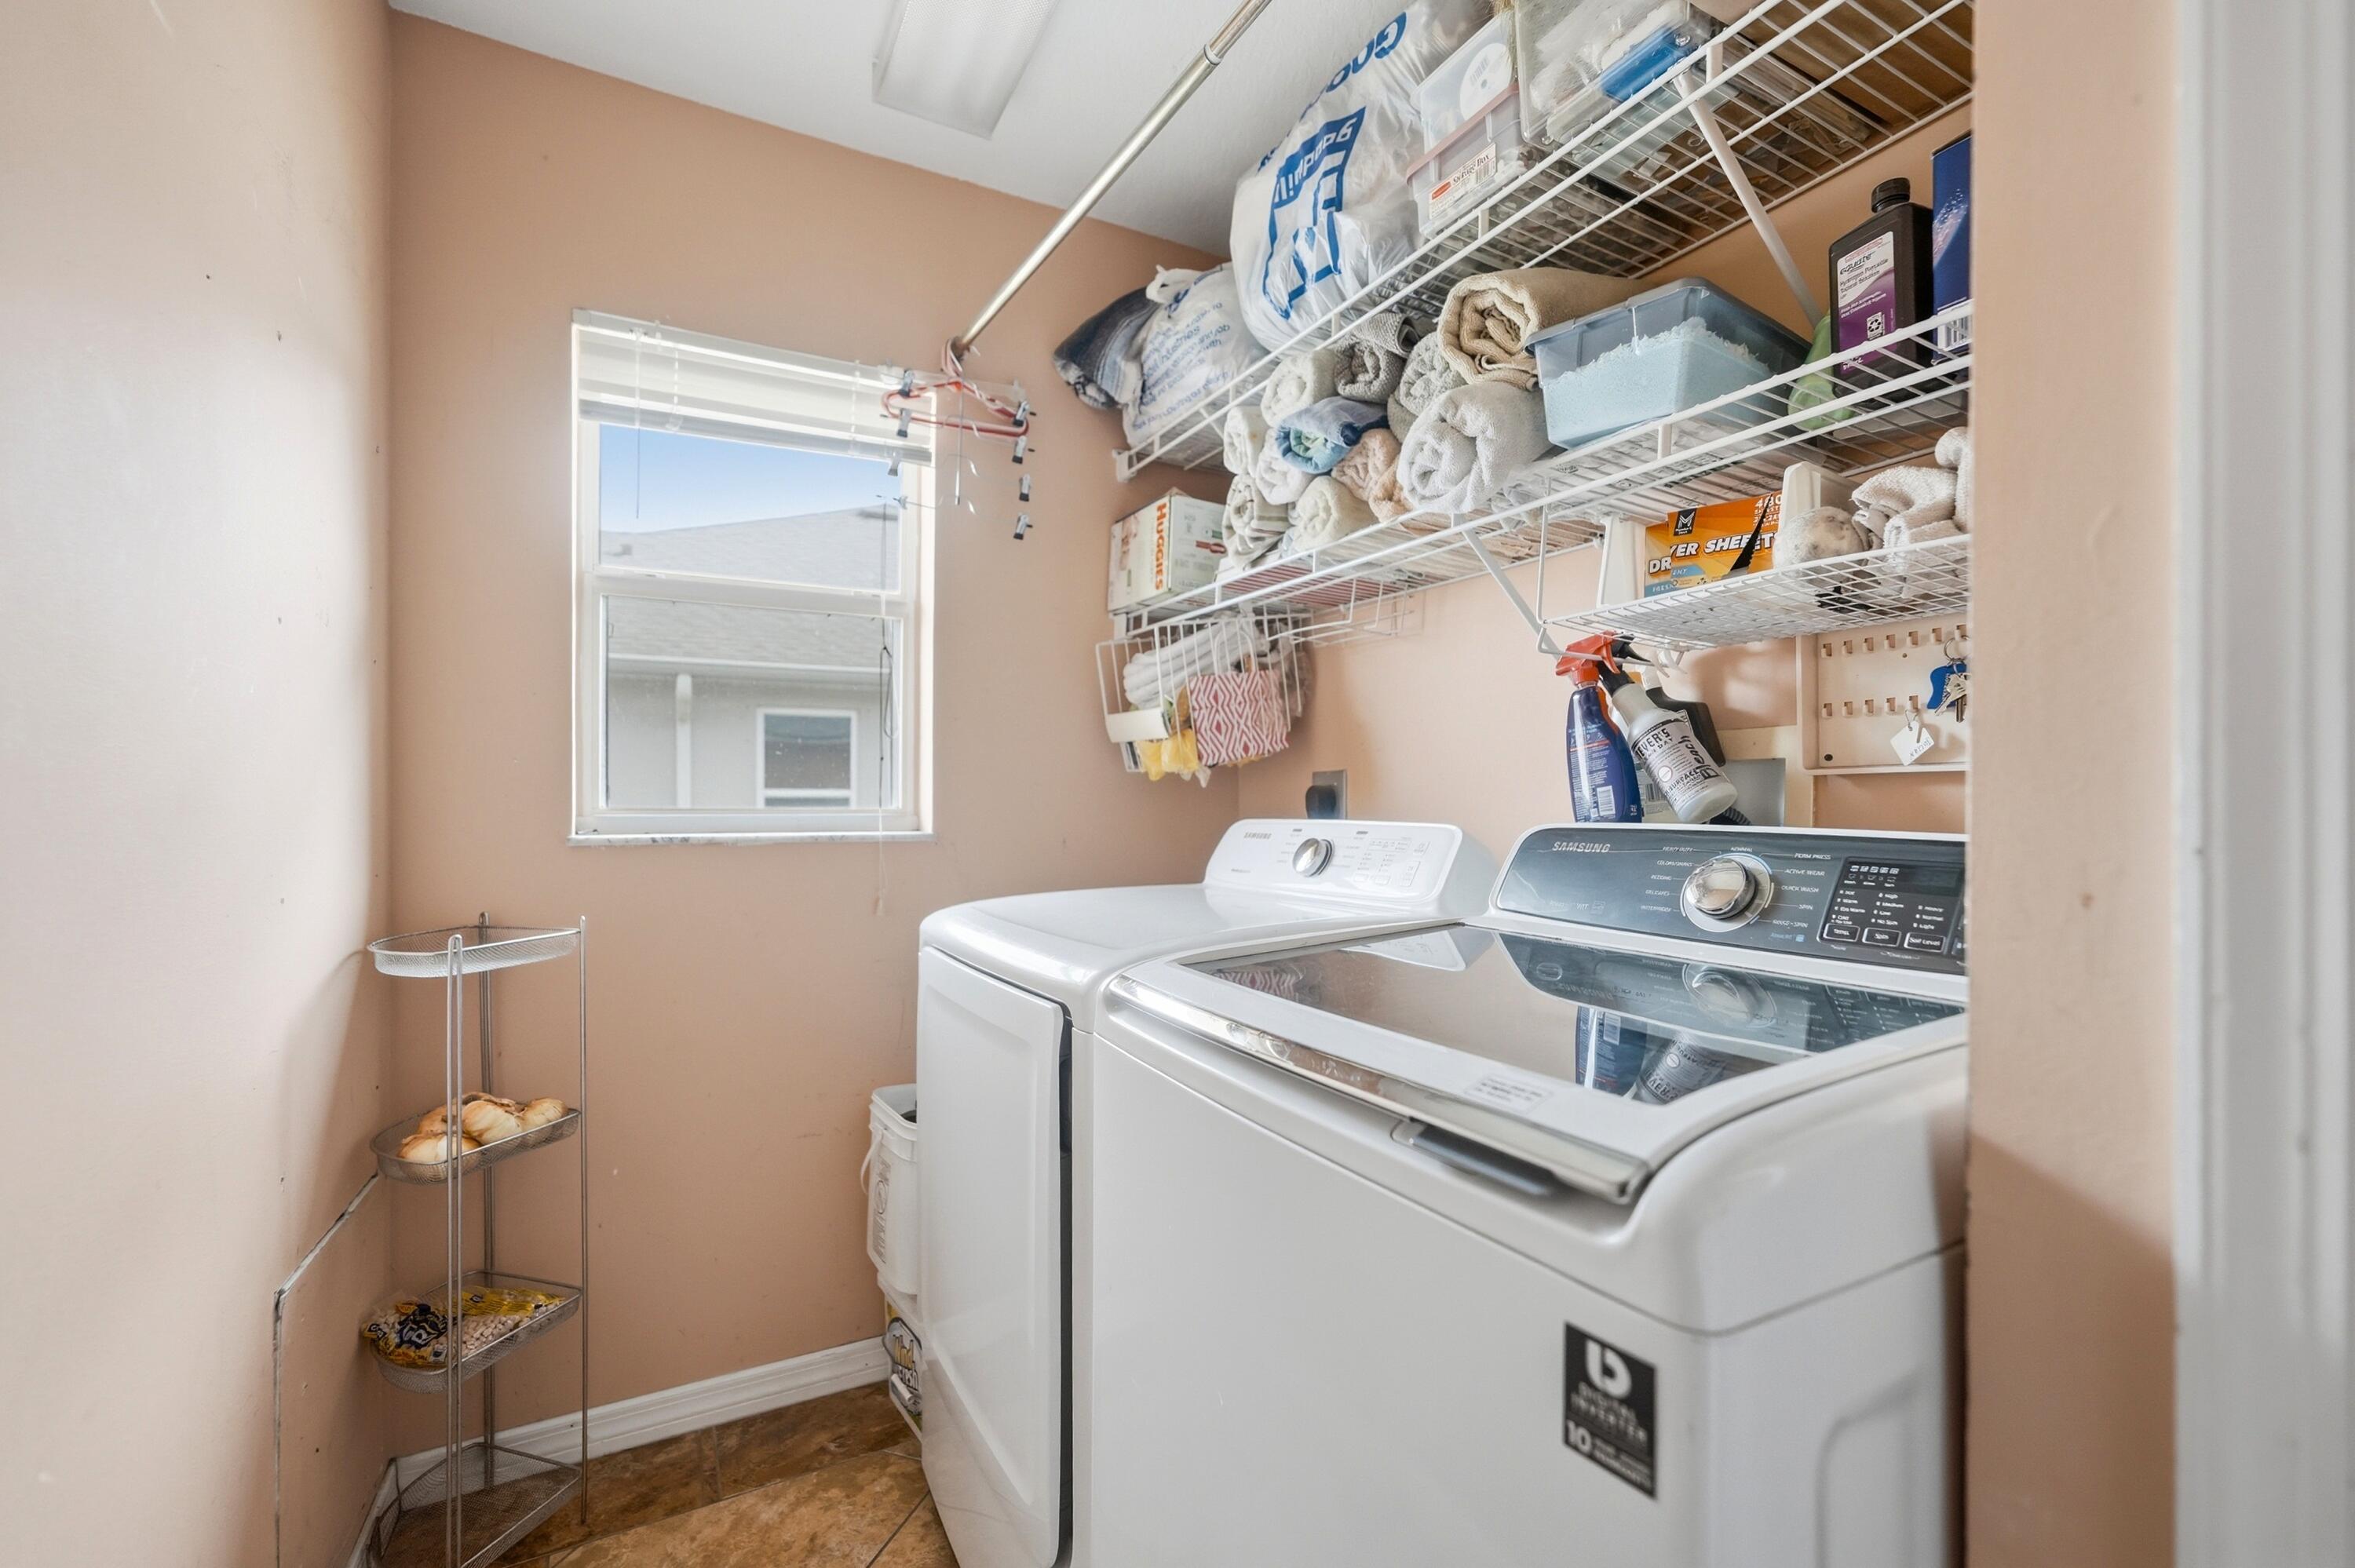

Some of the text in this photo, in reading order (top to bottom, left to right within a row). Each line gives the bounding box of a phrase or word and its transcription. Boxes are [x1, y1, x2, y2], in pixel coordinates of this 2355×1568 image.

[1156, 502, 1168, 591] HUGGIES
[1552, 841, 1611, 853] SAMSUNG
[1566, 1420, 1593, 1455] 10
